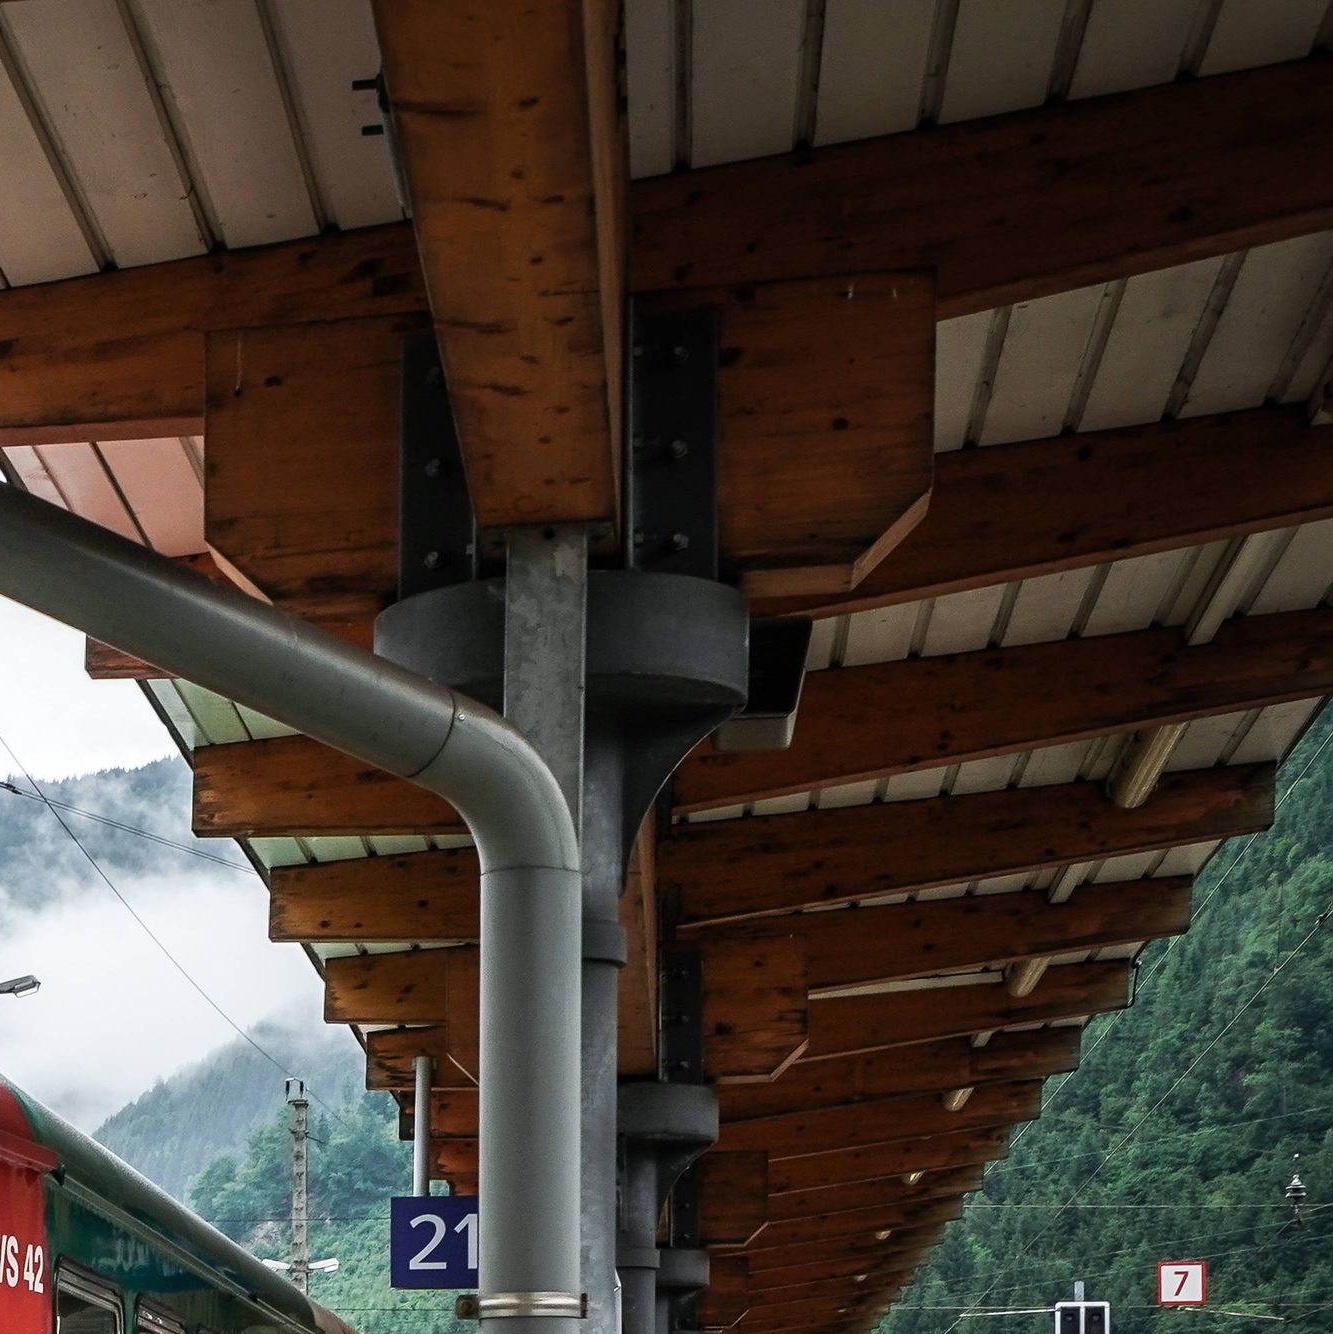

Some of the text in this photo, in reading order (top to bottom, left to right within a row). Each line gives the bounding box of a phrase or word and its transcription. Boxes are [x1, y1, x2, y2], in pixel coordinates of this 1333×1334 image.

[409, 1213, 478, 1270] 21
[23, 1244, 44, 1294] 42
[1174, 1271, 1189, 1296] 7
